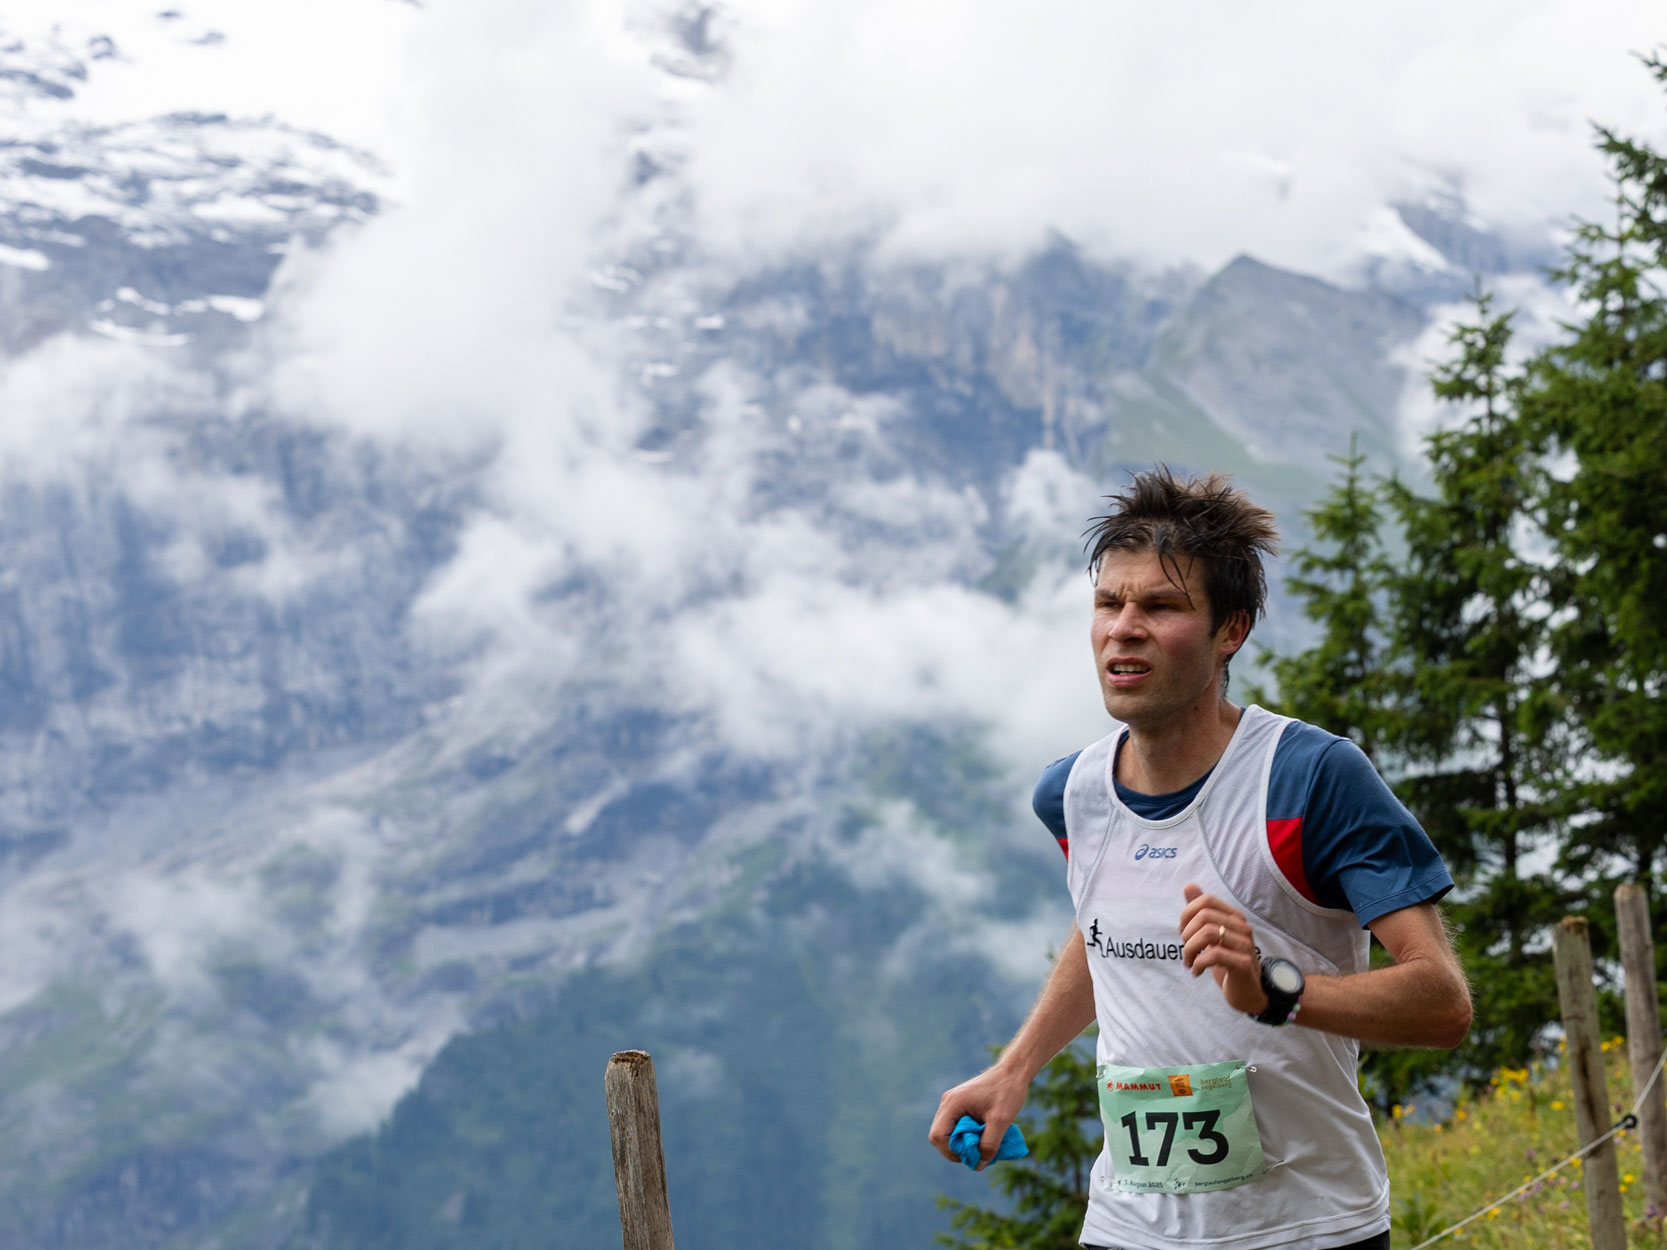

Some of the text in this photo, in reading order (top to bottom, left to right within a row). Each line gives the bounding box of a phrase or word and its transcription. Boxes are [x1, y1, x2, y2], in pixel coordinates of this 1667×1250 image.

[1148, 847, 1178, 859] asics
[1116, 1082, 1161, 1091] MAMMUT
[1120, 1109, 1230, 1167] 173
